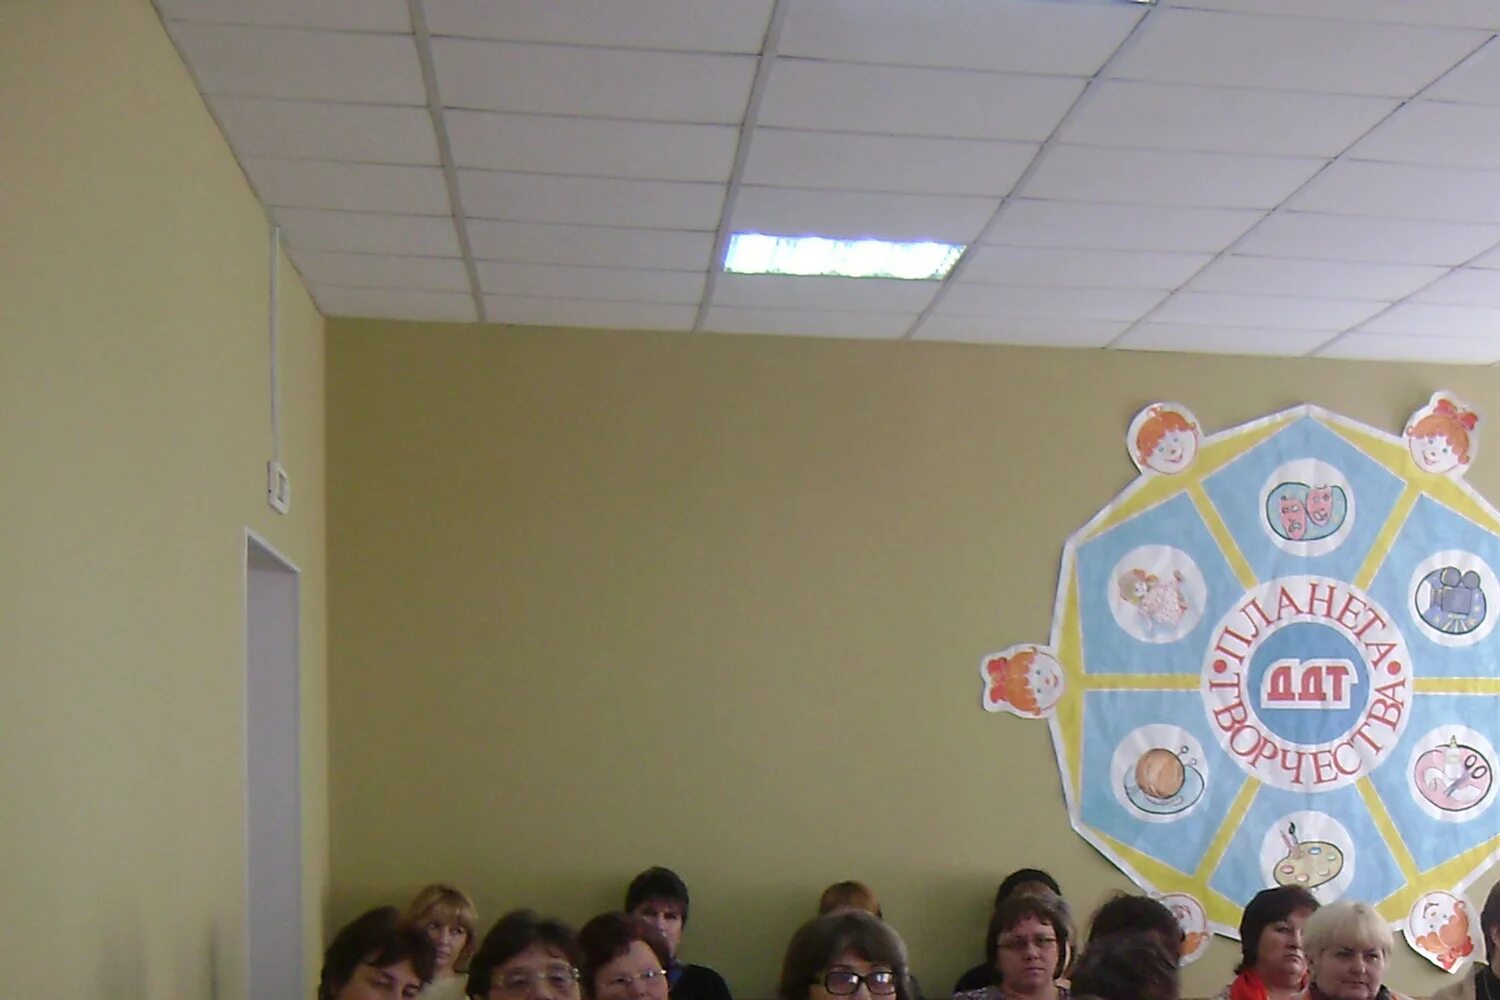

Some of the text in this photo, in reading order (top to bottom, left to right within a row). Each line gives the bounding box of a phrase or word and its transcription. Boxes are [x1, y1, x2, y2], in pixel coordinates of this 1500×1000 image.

[1214, 582, 1398, 669] ПЛАНЕТА
[1266, 665, 1350, 701] ДДТ
[1209, 672, 1407, 784] ТВОРЧЕСТВА
